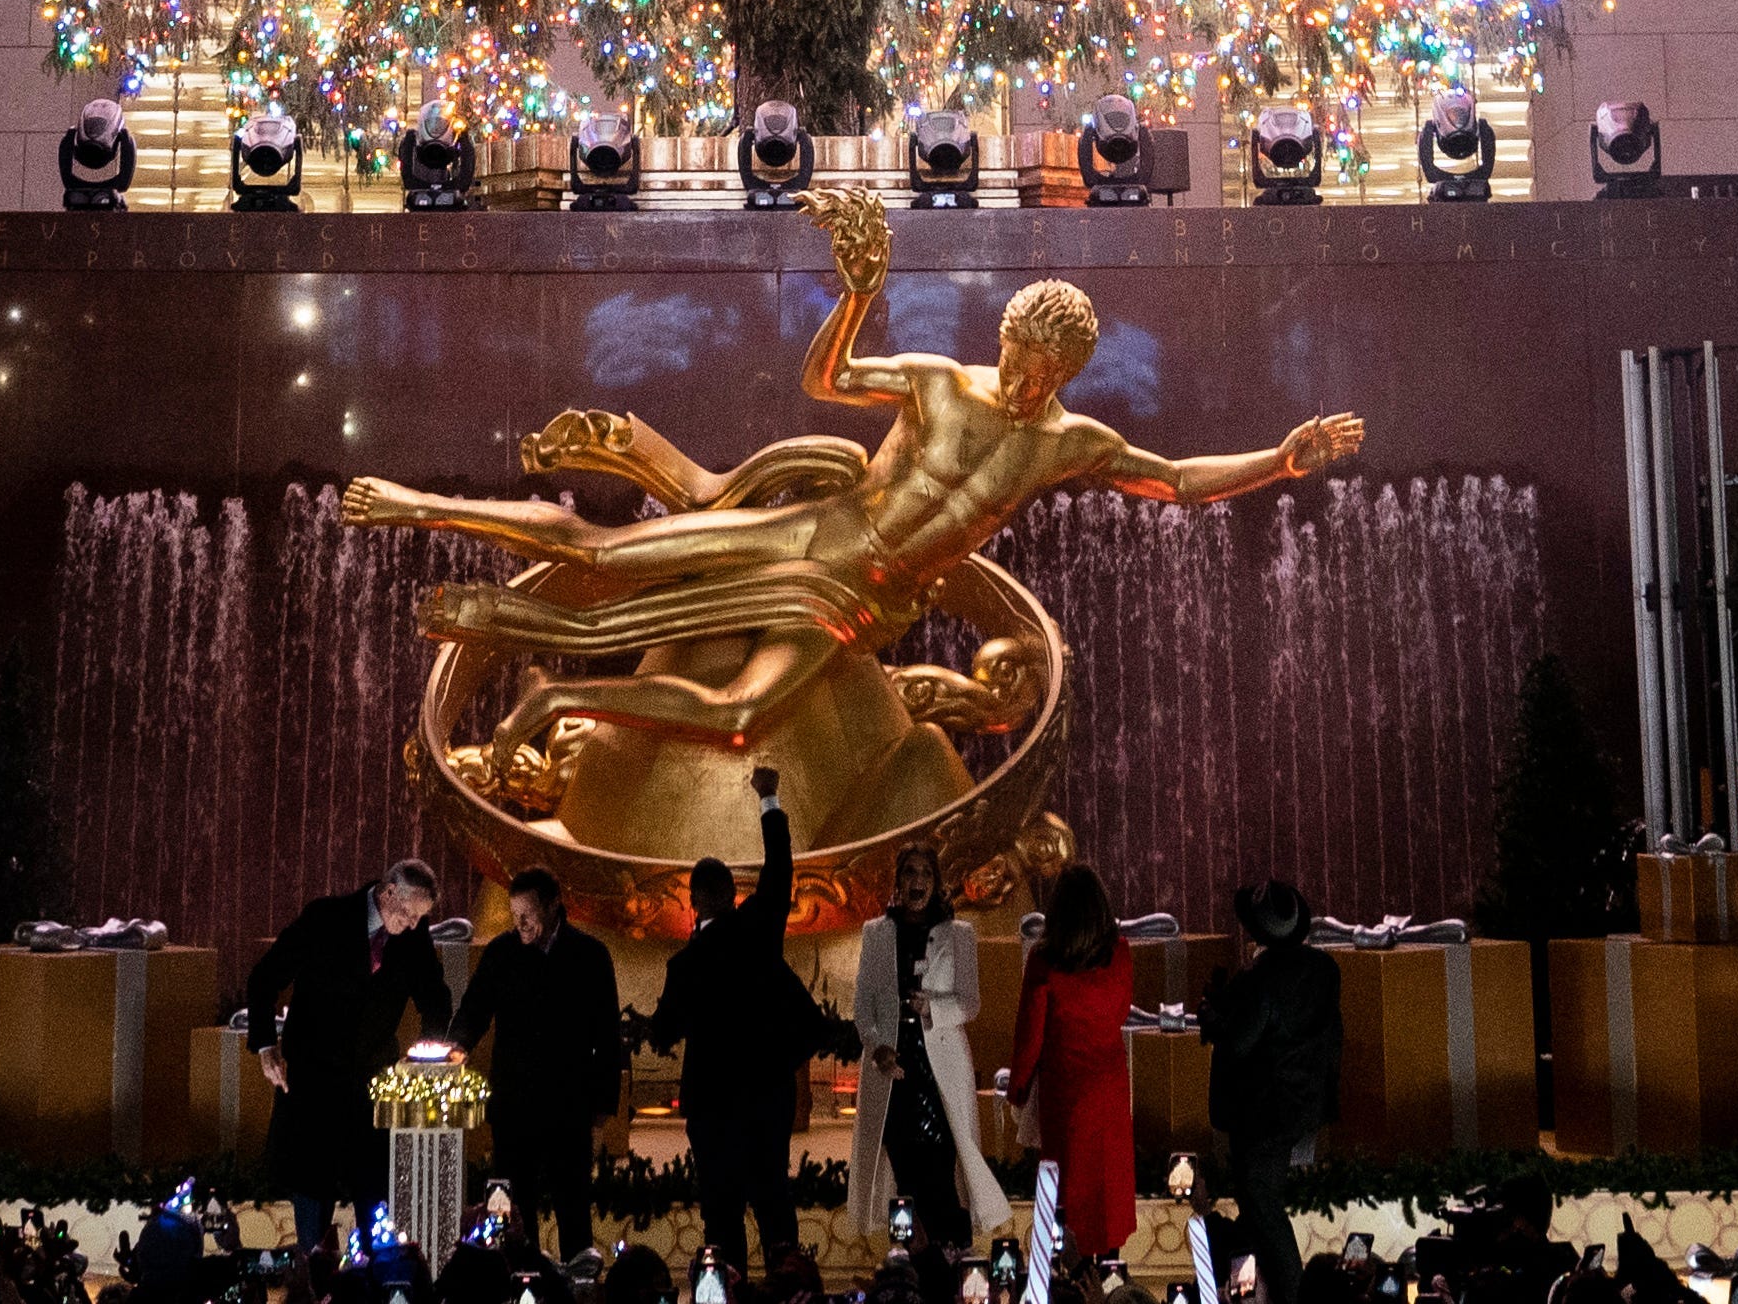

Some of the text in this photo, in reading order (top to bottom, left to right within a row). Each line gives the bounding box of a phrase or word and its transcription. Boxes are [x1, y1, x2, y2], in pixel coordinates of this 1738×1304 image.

[183, 222, 478, 242] TEACHER
[85, 250, 336, 269] PROVED
[415, 250, 480, 269] TO
[1029, 247, 1236, 268] MEANS
[1317, 244, 1380, 263] TO
